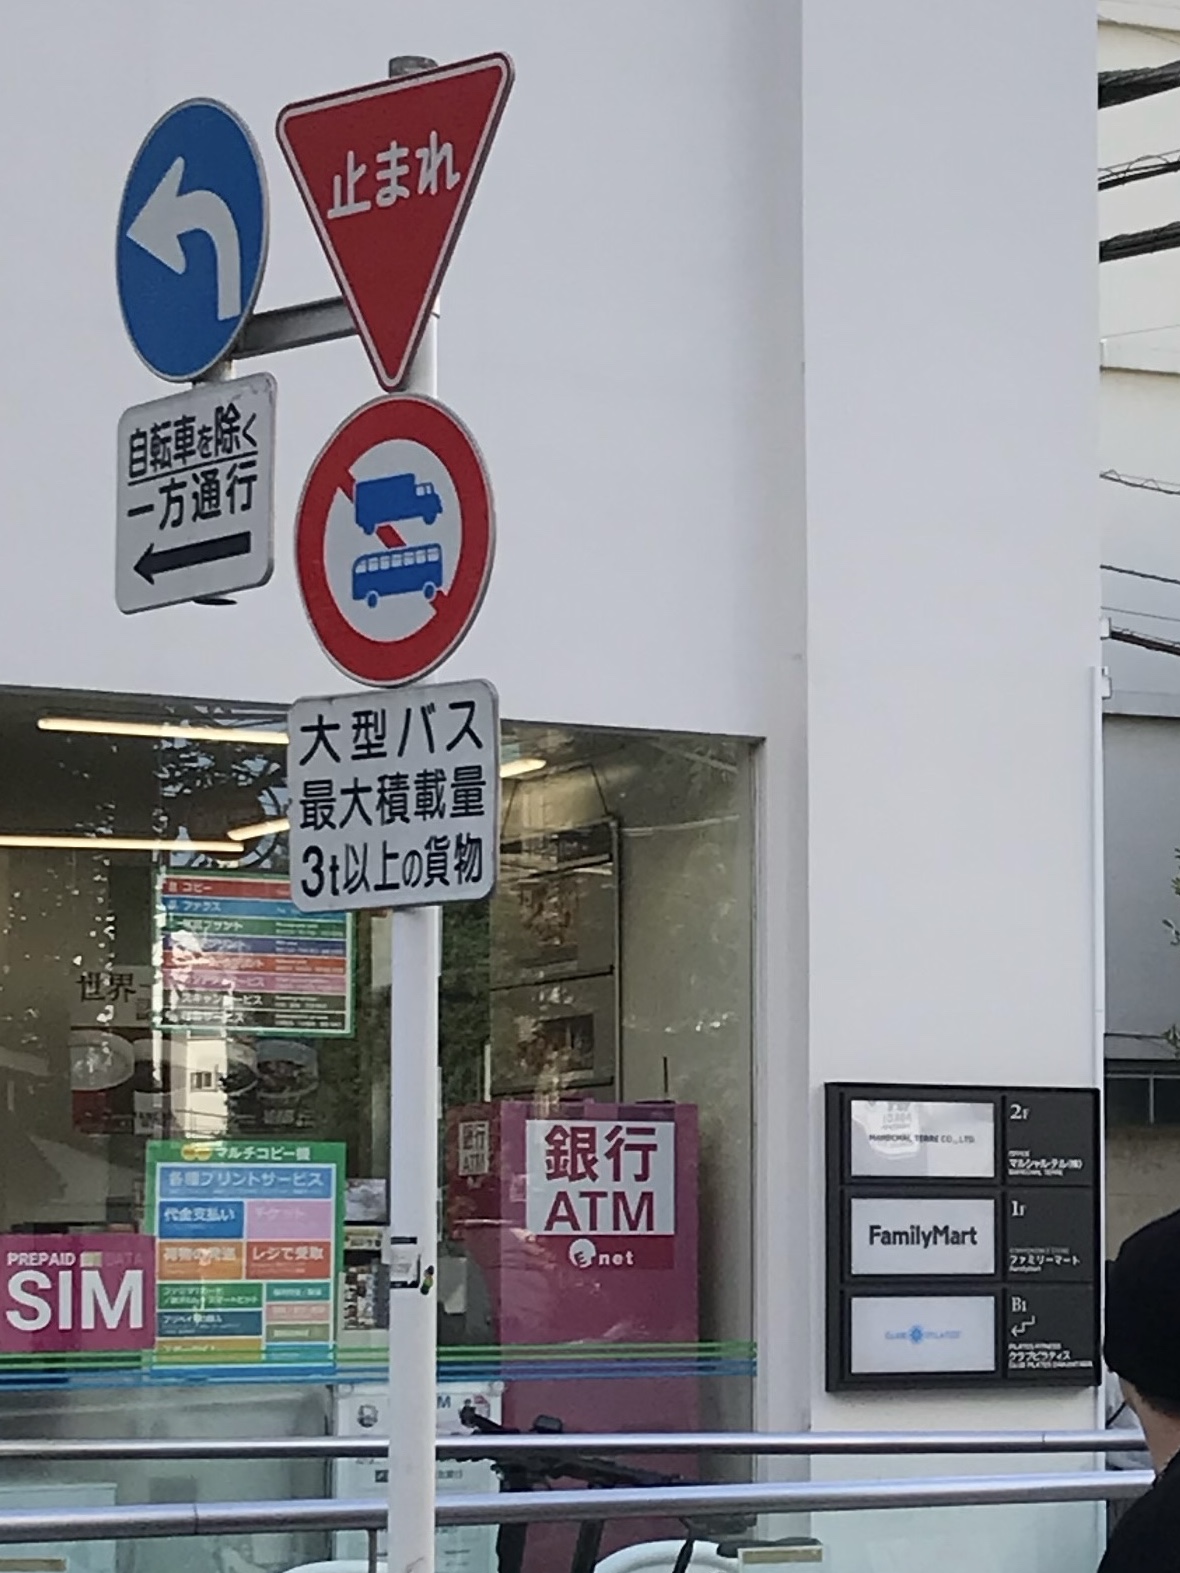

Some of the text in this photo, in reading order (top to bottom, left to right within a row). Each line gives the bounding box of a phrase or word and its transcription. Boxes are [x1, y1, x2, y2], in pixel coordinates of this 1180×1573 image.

[327, 130, 461, 219] 止まれ
[128, 405, 257, 473] 自転車を除く
[127, 461, 257, 530] 一方通行
[300, 703, 485, 766] 大型バス
[299, 768, 486, 830] 最大積載量
[302, 832, 484, 897] 3t以上の貨物
[545, 1125, 657, 1183] 銀行
[545, 1191, 654, 1231] ATM
[869, 1225, 978, 1248] FamilyMart
[7, 1251, 76, 1266] PREPAID
[6, 1270, 143, 1331] SIM
[1011, 1296, 1027, 1312] B1
